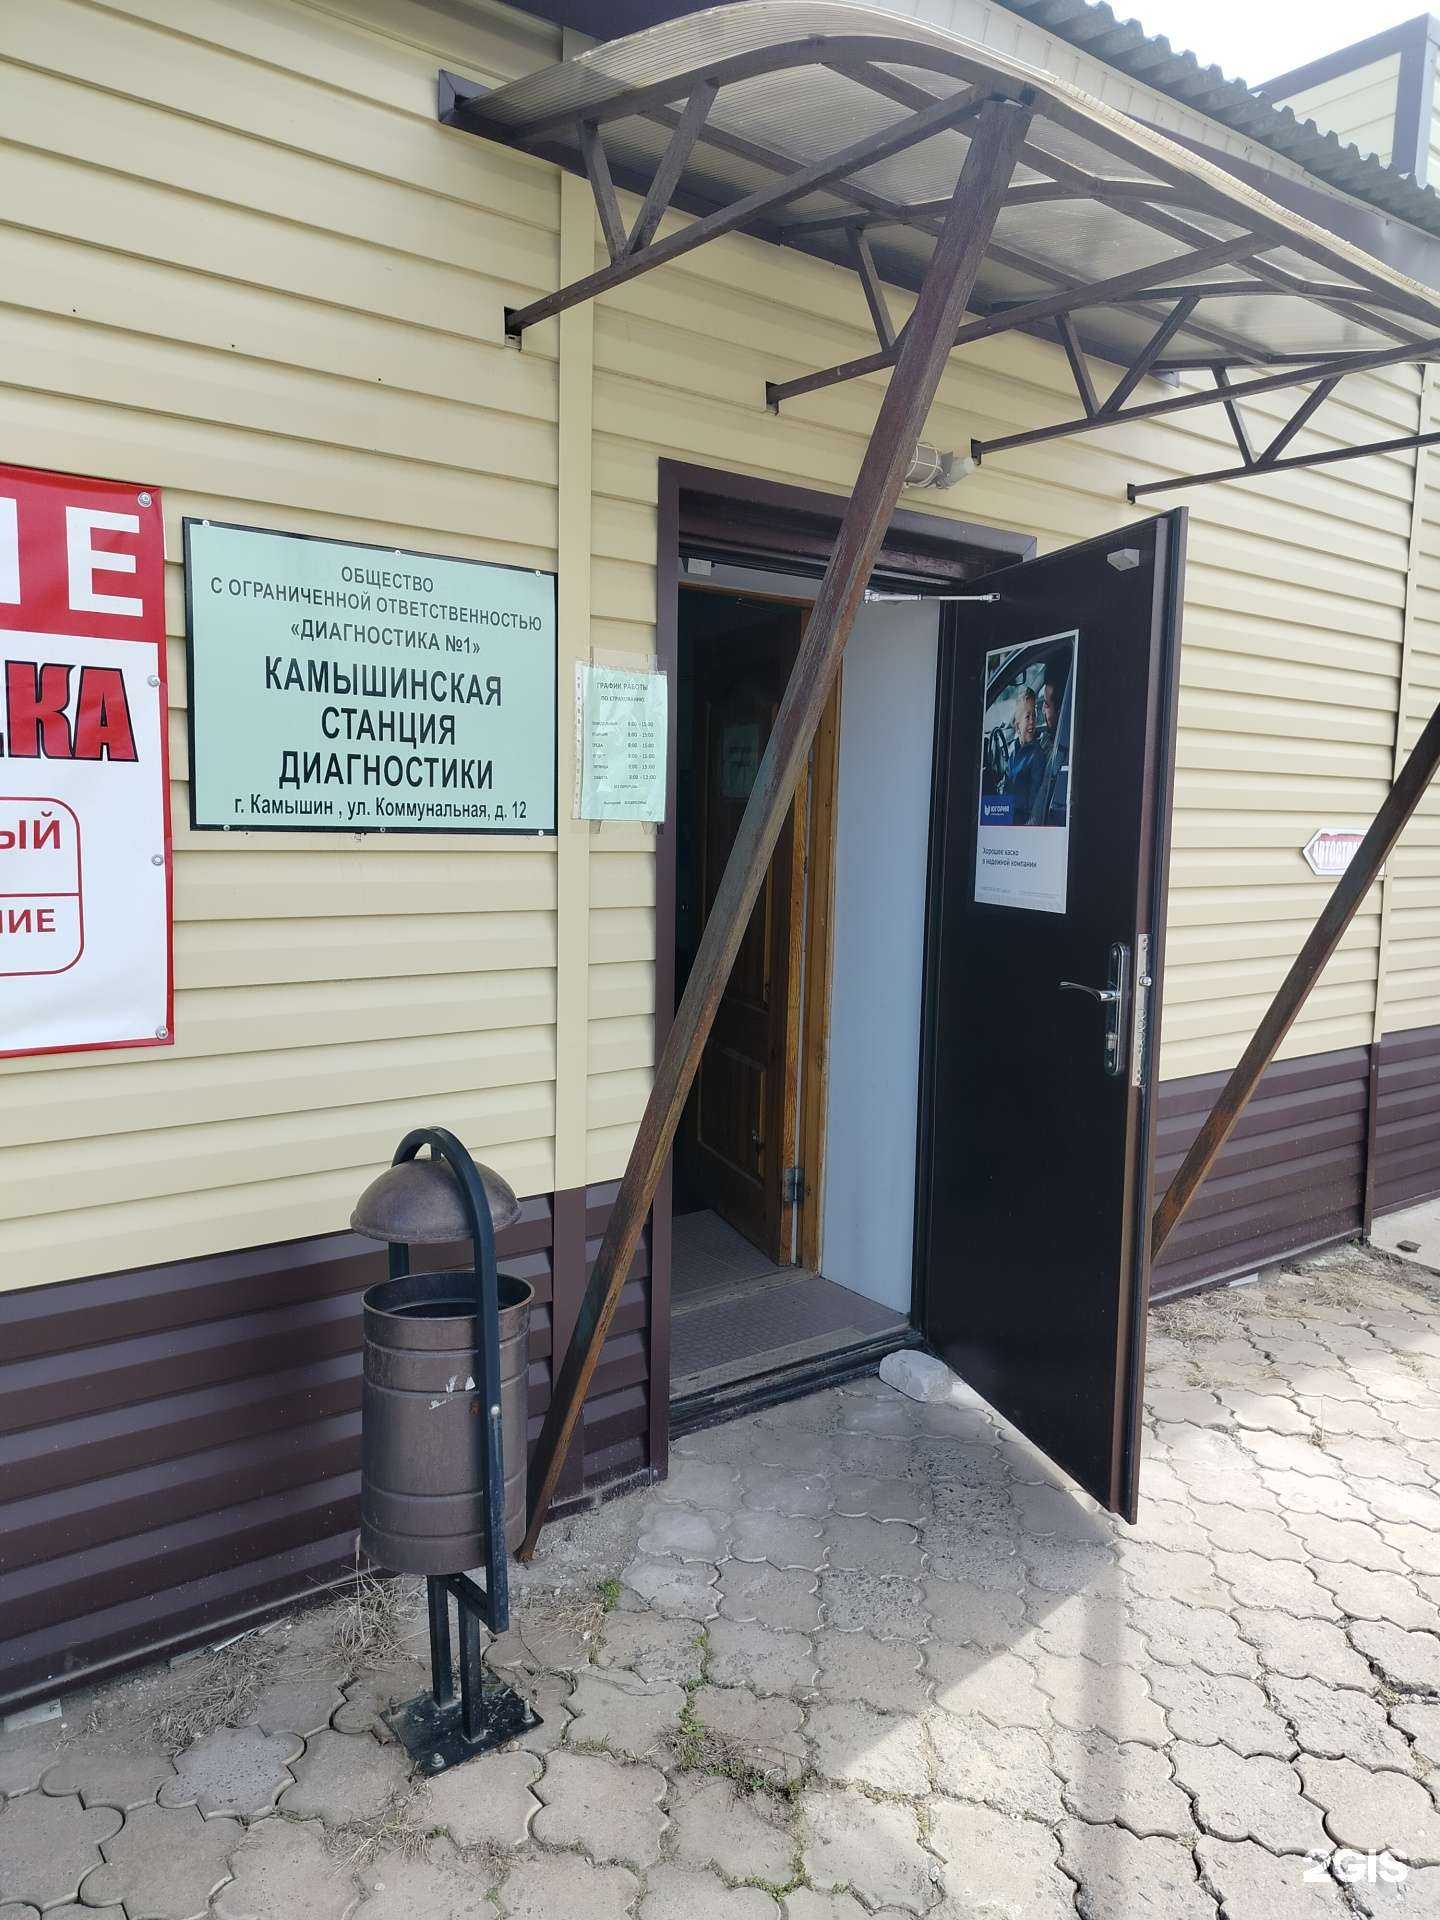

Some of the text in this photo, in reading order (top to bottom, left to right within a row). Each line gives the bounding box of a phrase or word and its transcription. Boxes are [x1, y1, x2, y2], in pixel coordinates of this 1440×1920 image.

[341, 566, 434, 593] ОБЩЕСТВО
[211, 577, 542, 631] С ОГРАНИЧЕННОЙ ОТВЕТСТВЕННОСТЬЮ
[291, 619, 481, 655] «ДИАГНОСТИКА №1»
[265, 655, 502, 706] КАМЫШИНСКАЯ
[0, 660, 139, 762] КА
[321, 706, 456, 749] СТАНЦИЯ
[279, 751, 494, 790] ДИАГНОСТИКИ
[250, 794, 333, 815] Камышин
[347, 799, 371, 819] ул.
[375, 797, 491, 821] Коммунальная,
[494, 803, 508, 821] д.
[511, 800, 528, 819] 12
[0, 908, 55, 933] ИЕ
